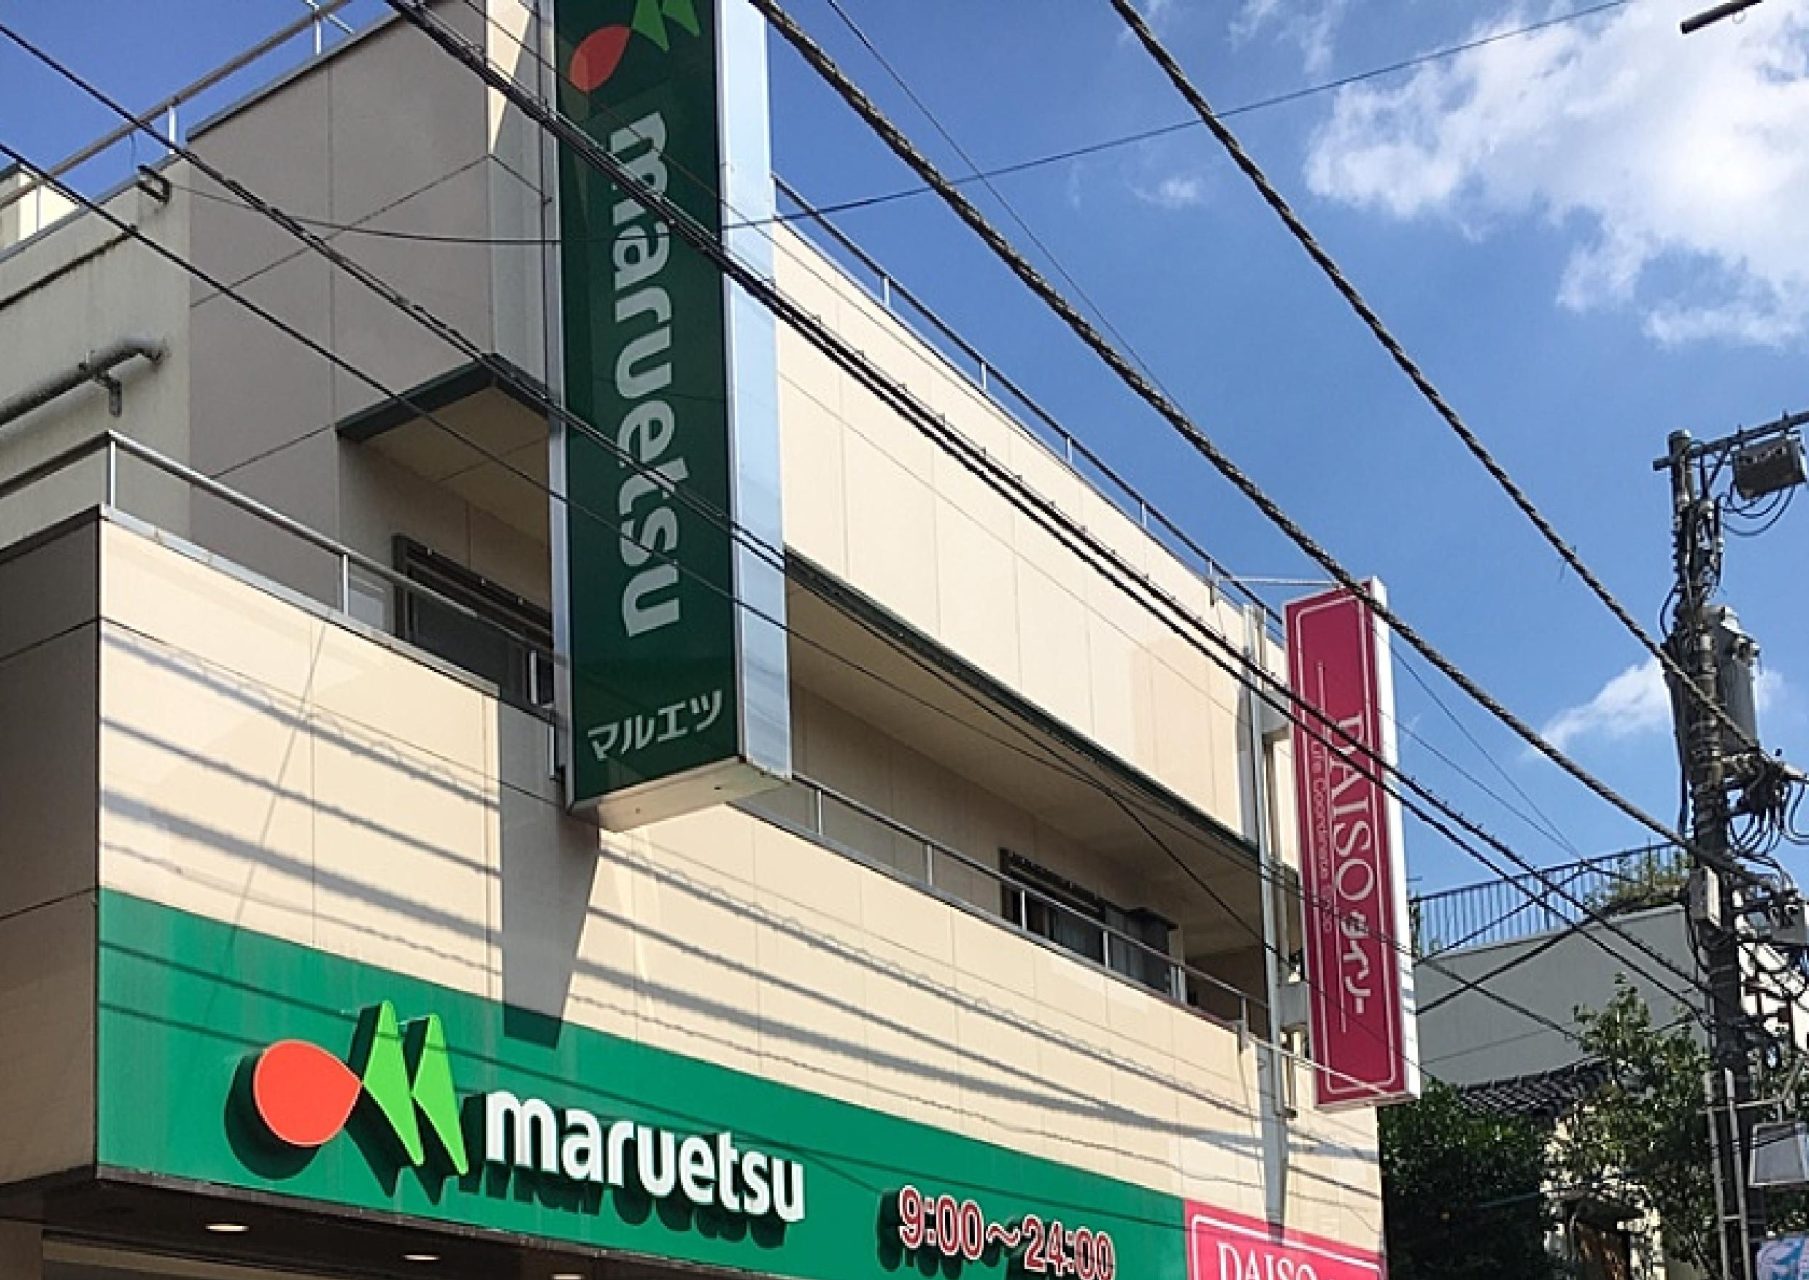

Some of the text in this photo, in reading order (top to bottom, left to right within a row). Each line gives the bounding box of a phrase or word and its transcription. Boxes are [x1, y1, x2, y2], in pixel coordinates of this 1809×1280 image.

[606, 110, 690, 638] maruetsu
[587, 688, 723, 763] マルエツ
[1331, 713, 1374, 901] DAISO
[485, 1090, 805, 1223] maruetsu
